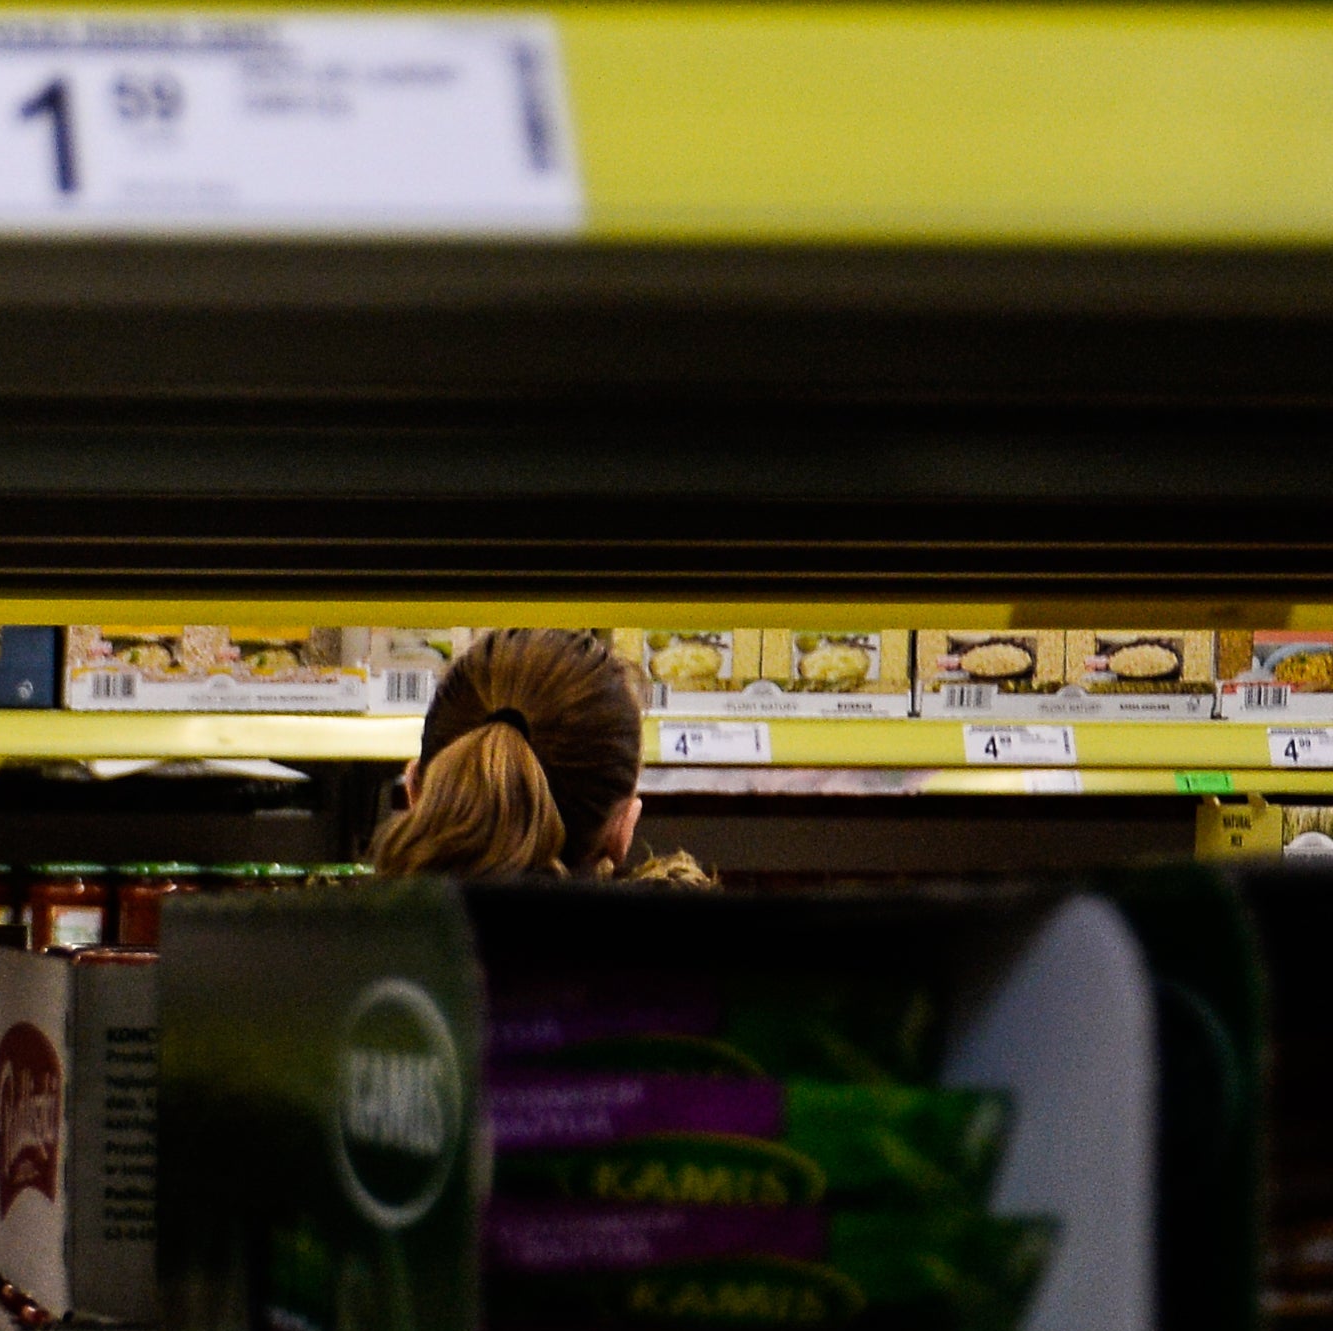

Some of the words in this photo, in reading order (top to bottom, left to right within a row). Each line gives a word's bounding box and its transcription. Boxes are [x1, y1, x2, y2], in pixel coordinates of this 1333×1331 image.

[18, 75, 81, 195] 1
[984, 736, 999, 760] 4
[1284, 738, 1300, 763] 4
